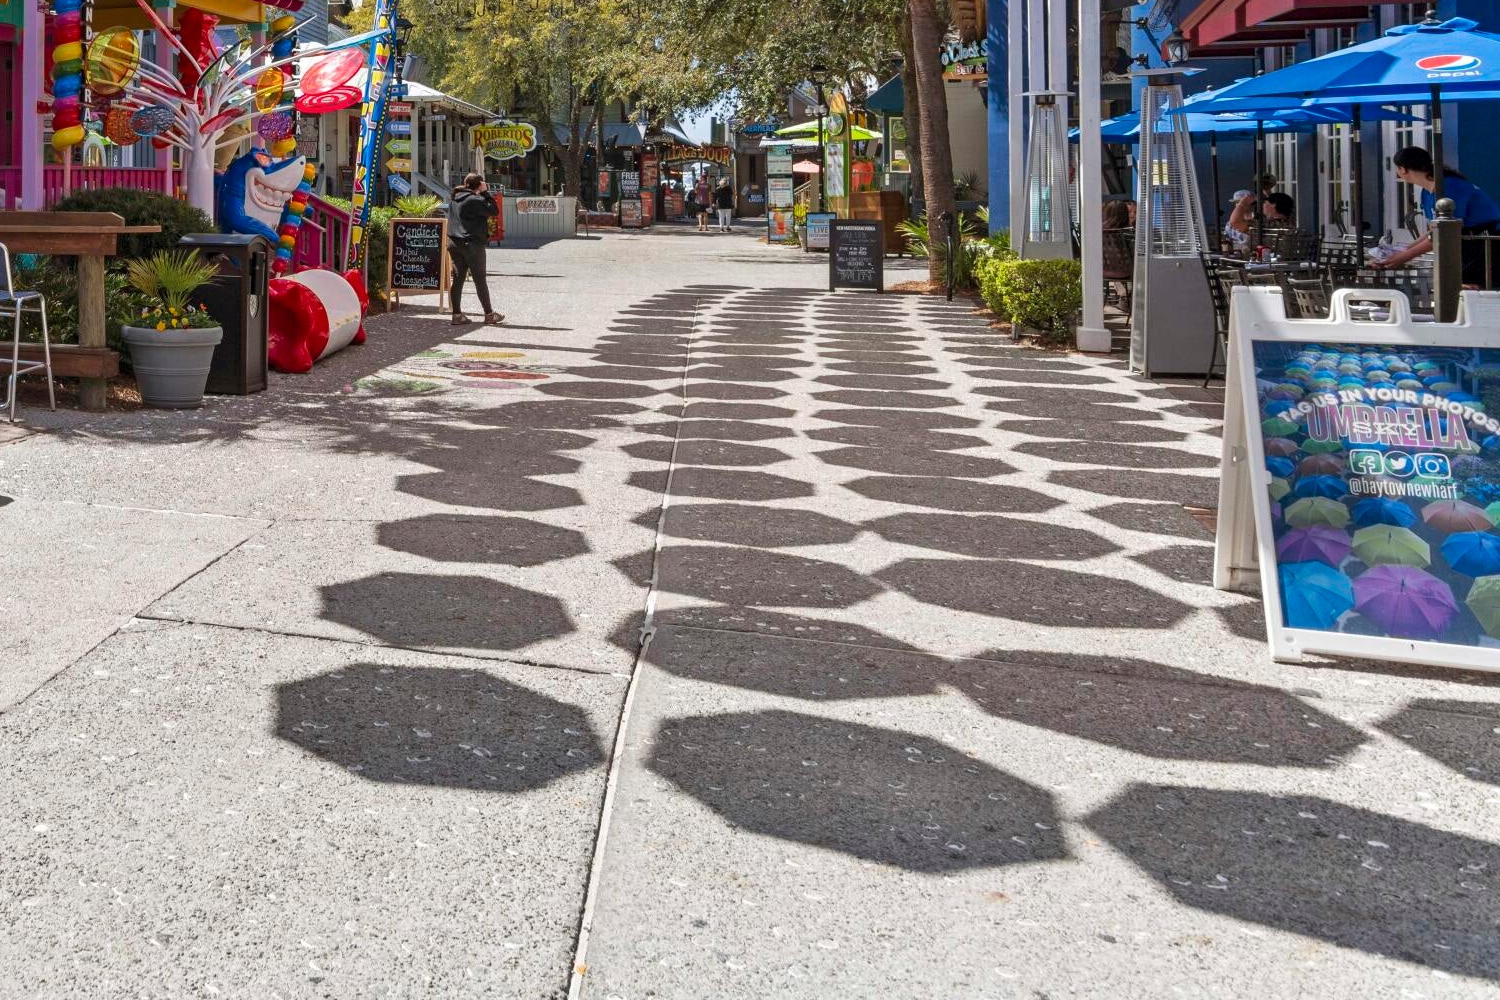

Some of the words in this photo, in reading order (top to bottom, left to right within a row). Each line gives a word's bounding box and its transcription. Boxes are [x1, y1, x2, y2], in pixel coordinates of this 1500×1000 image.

[1426, 71, 1482, 79] pepsi
[473, 128, 532, 148] ROBERTO'S
[661, 145, 697, 161] ILLAGE
[621, 172, 640, 180] FREE
[397, 224, 439, 237] Candied
[396, 247, 419, 256] Dubai
[1277, 401, 1314, 423] TAG
[1314, 392, 1339, 408] US
[1337, 390, 1362, 402] IN
[1363, 387, 1418, 404] YOUR
[1306, 403, 1472, 450] UMBRELLA
[1352, 422, 1422, 437] SKY
[1349, 477, 1458, 500] @baytownewharf
